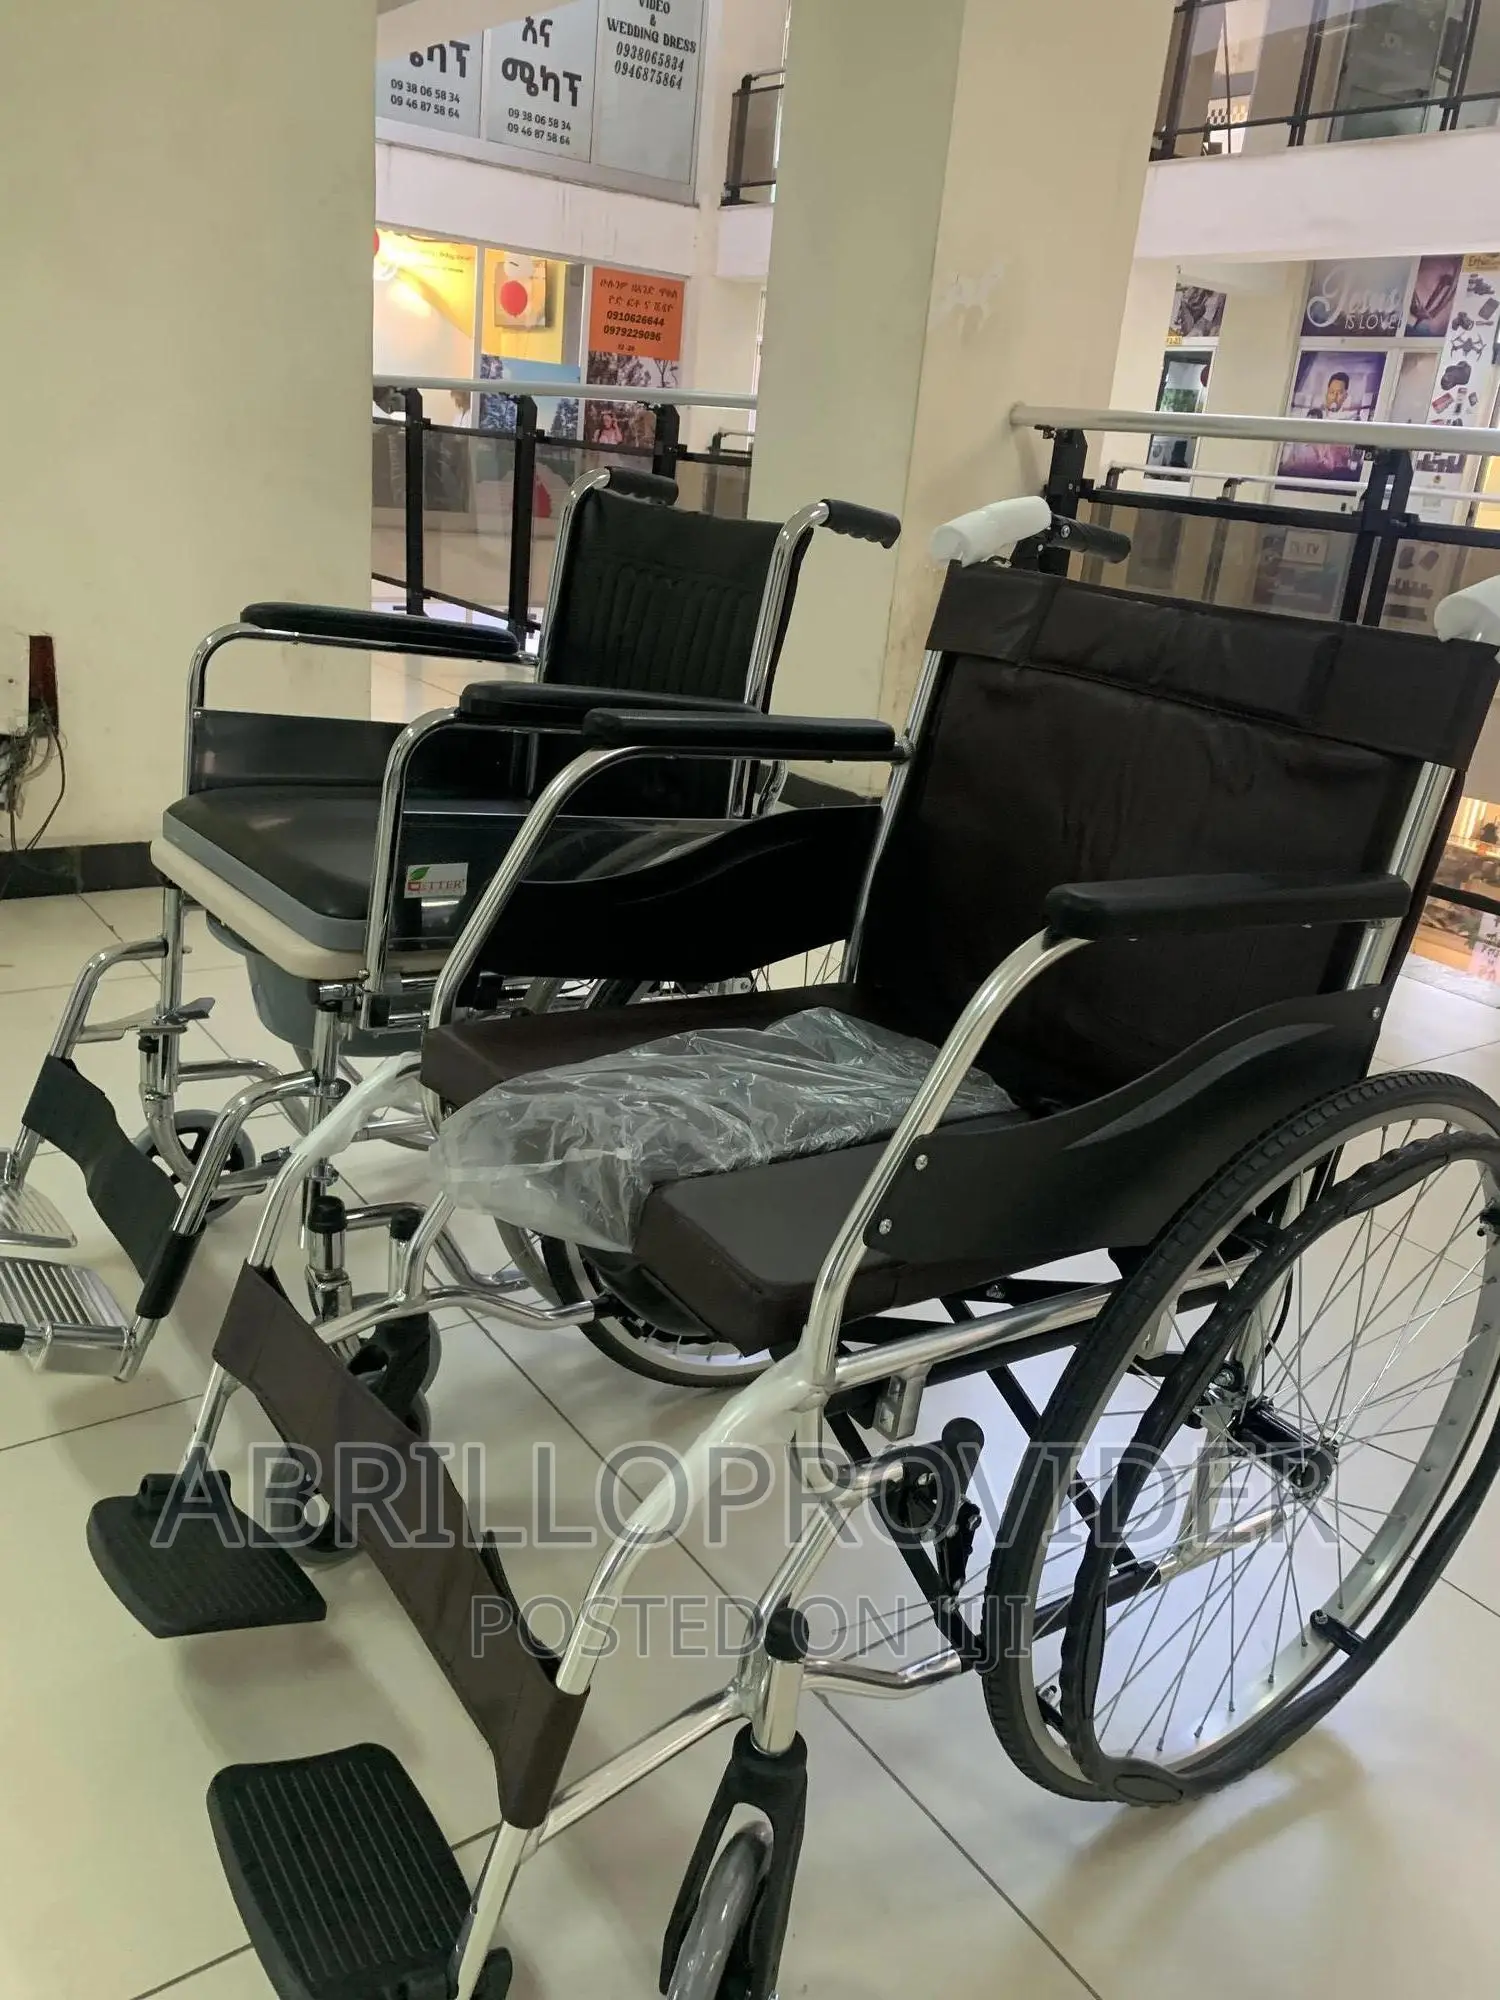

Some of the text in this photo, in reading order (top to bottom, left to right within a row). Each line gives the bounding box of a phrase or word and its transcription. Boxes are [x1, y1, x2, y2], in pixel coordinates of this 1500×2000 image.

[522, 16, 553, 48] እና
[650, 14, 656, 27] &
[607, 16, 697, 54] WEDDING DRESS
[616, 41, 684, 73] 0938065834
[501, 57, 582, 107] ሜካፕ
[614, 60, 683, 90] 0946875864
[390, 78, 460, 104] 09 38 06 58 34
[390, 94, 460, 119] 09 46 87 58 64
[508, 107, 572, 131] 09 38 06 58 34
[507, 122, 571, 146] 09 46 87 58 64
